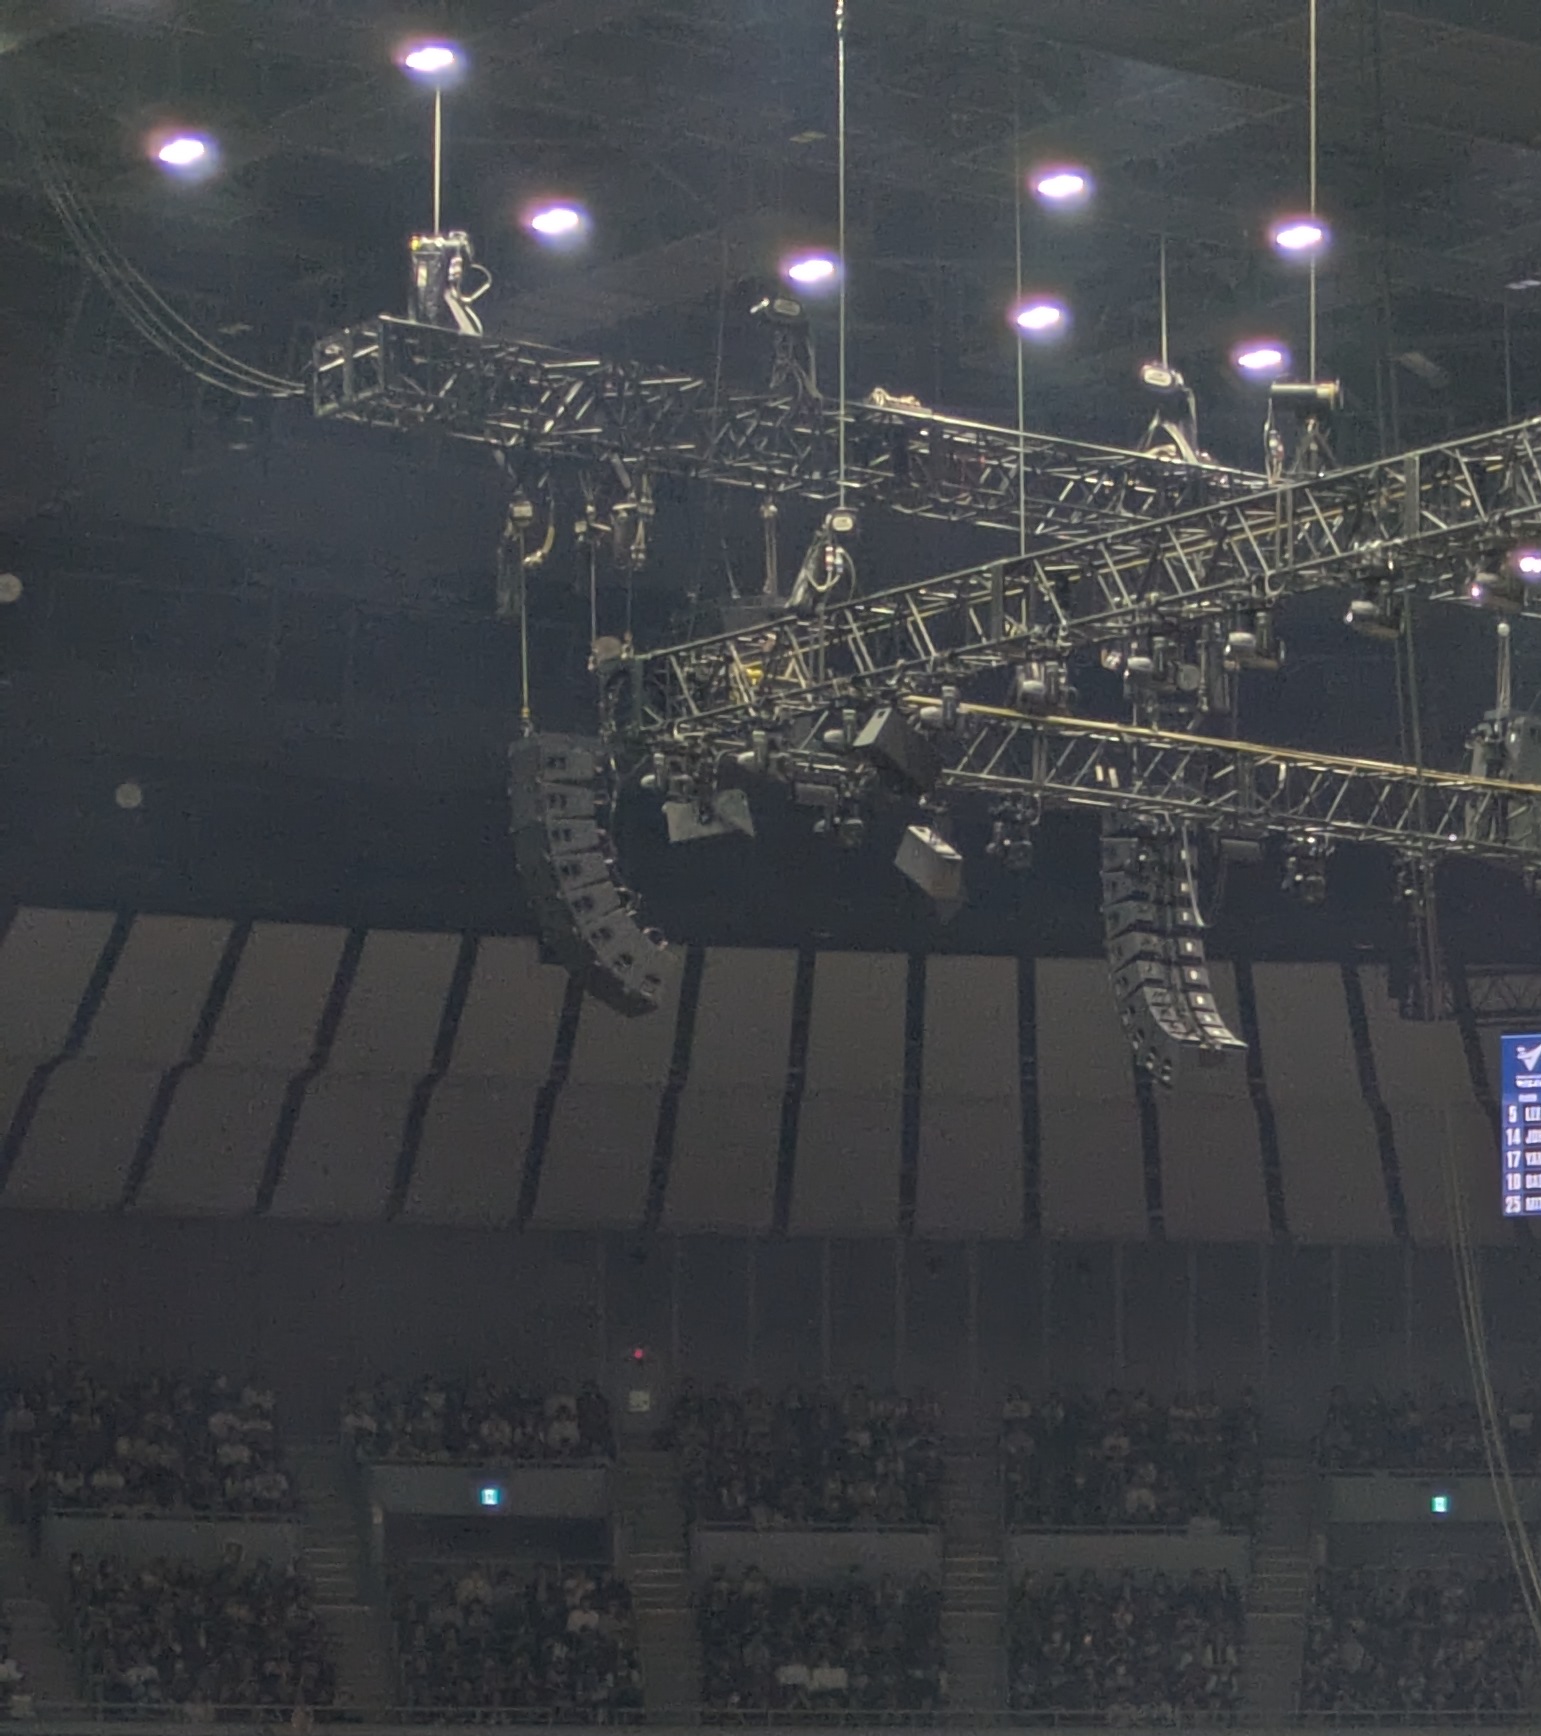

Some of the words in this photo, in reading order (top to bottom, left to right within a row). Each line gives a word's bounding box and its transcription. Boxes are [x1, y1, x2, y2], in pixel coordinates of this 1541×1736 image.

[1505, 1128, 1521, 1146] 14
[1506, 1150, 1521, 1168] 17
[1505, 1195, 1521, 1213] 25
